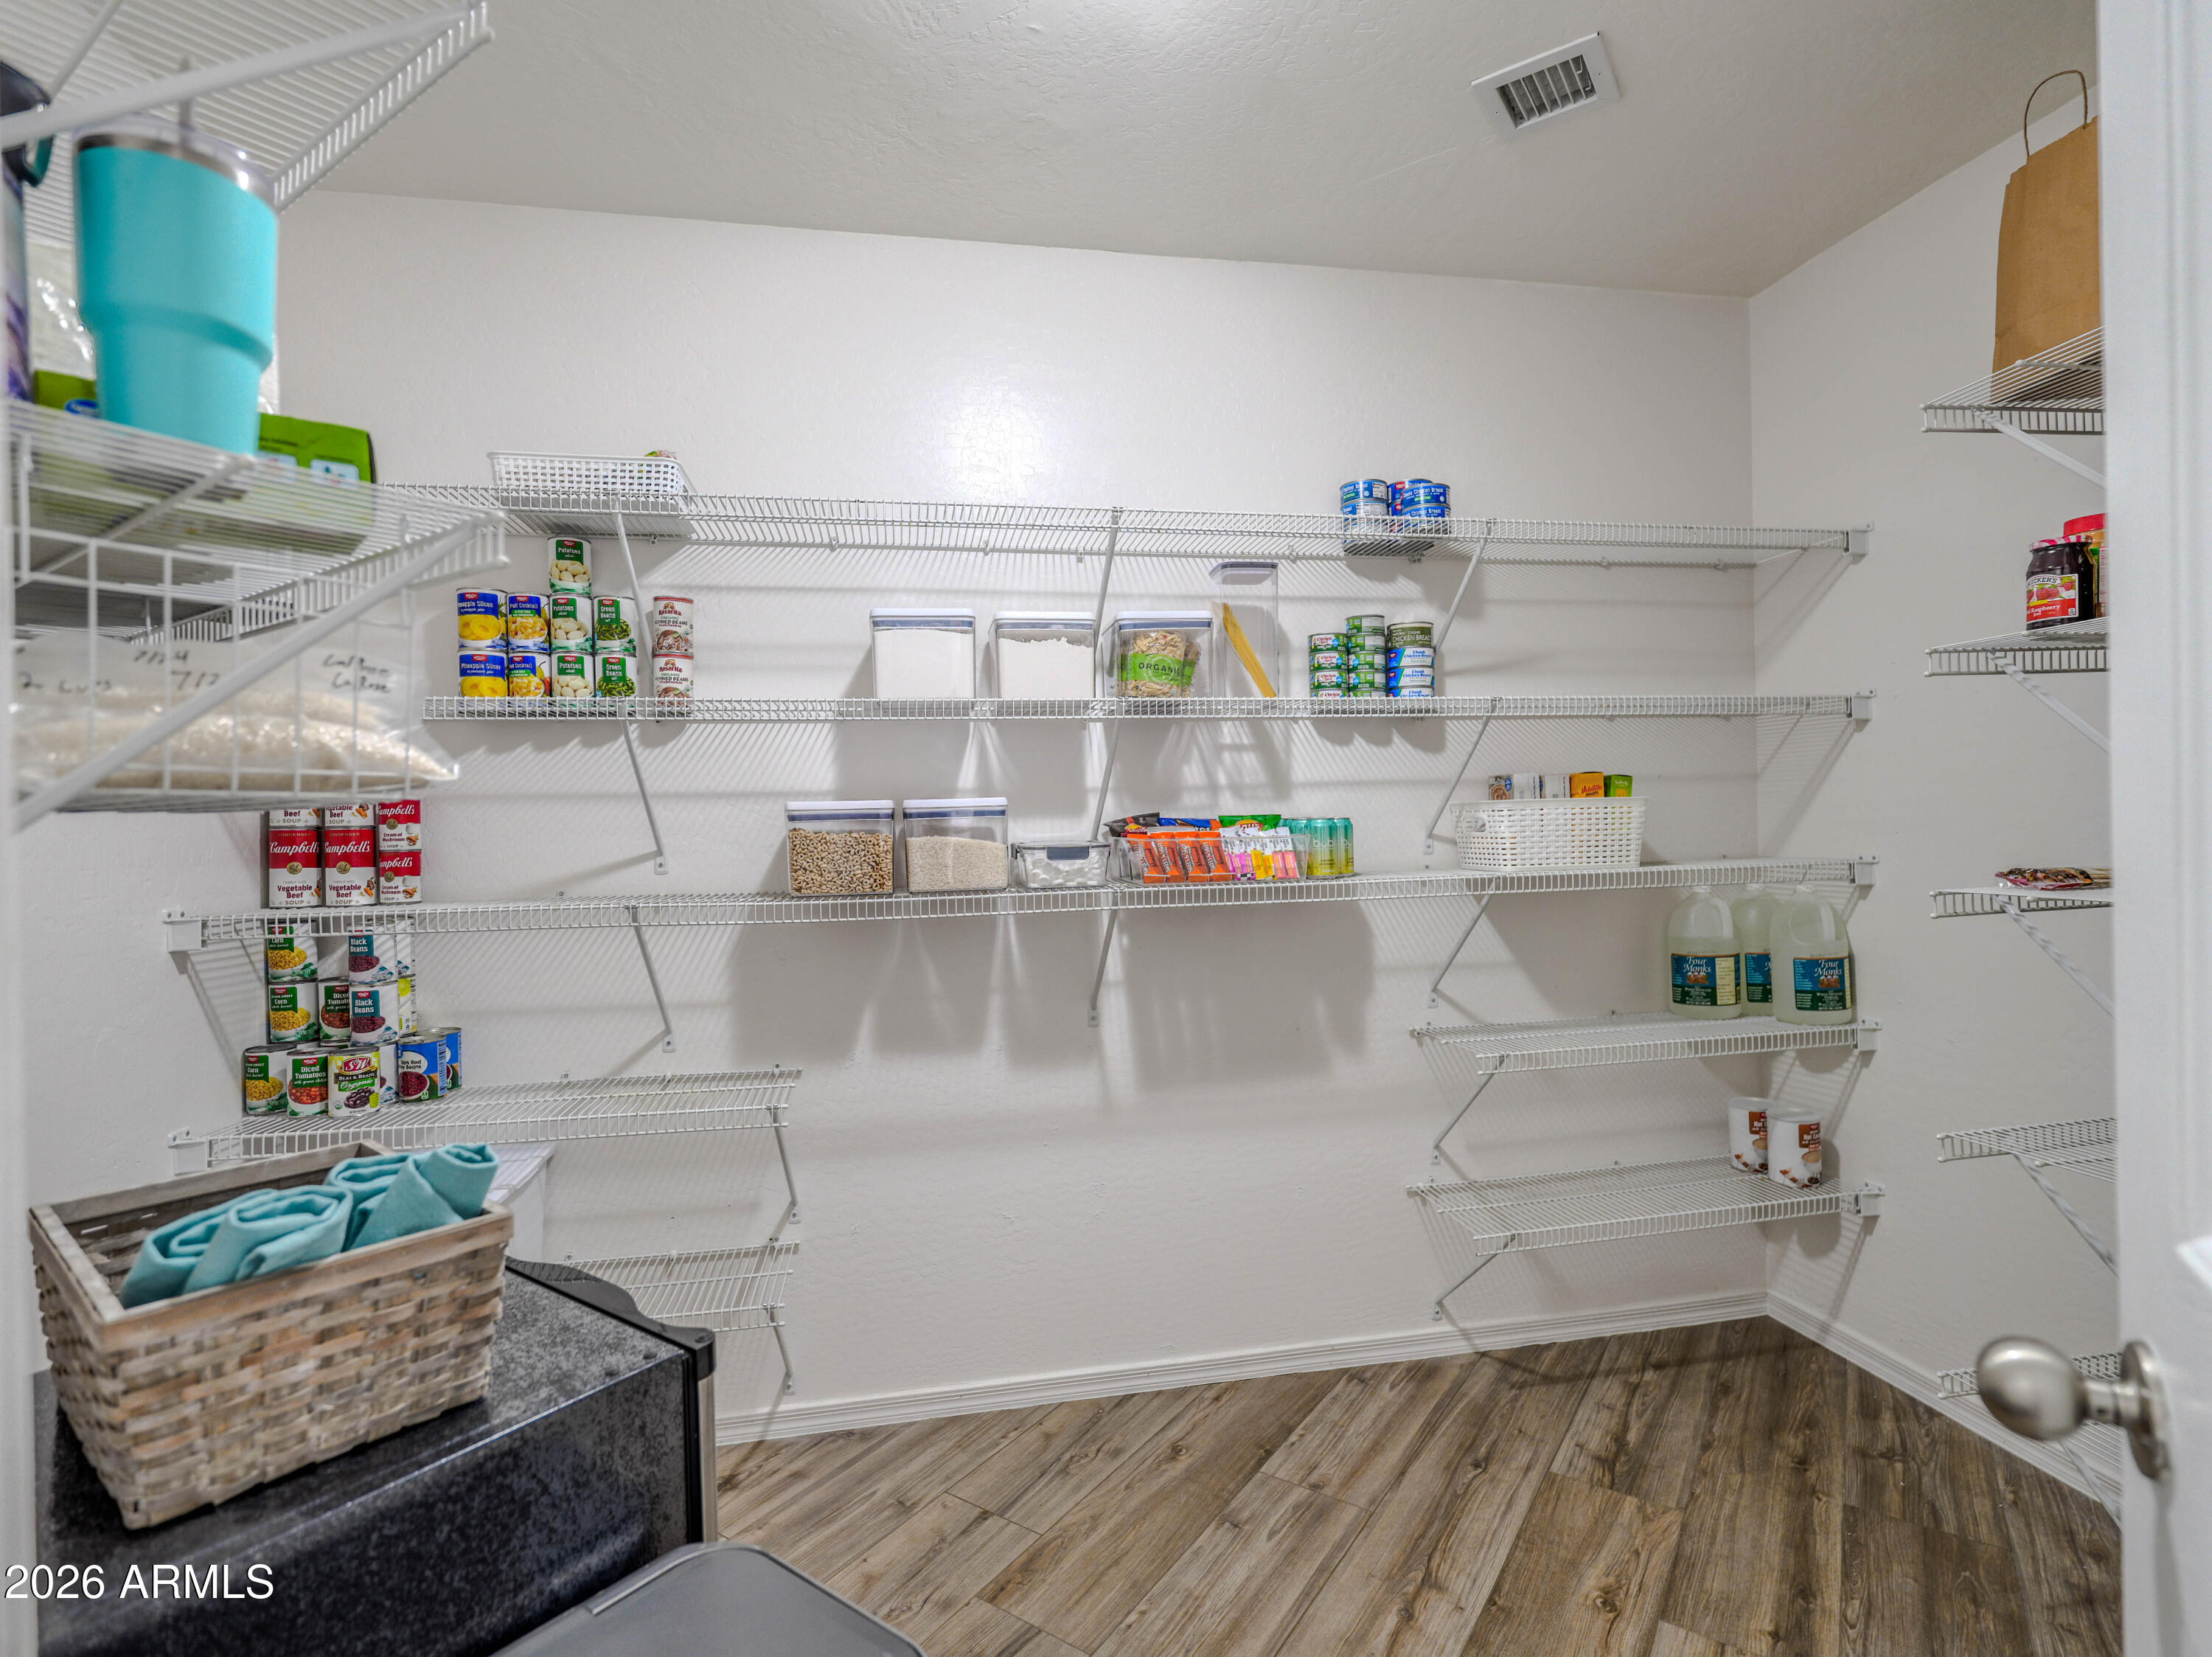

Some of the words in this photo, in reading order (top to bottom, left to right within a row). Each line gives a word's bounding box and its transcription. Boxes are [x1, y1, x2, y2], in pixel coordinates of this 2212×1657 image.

[2028, 577, 2058, 586] UCKER'S
[2031, 605, 2061, 613] Raspberry
[1582, 785, 1602, 794] Velveeta
[379, 857, 413, 869] ampbell's
[1686, 956, 1708, 965] Four
[1818, 959, 1840, 968] Four
[1683, 963, 1711, 973] Monks
[1814, 967, 1843, 976] Monks
[340, 1077, 373, 1091] Organic
